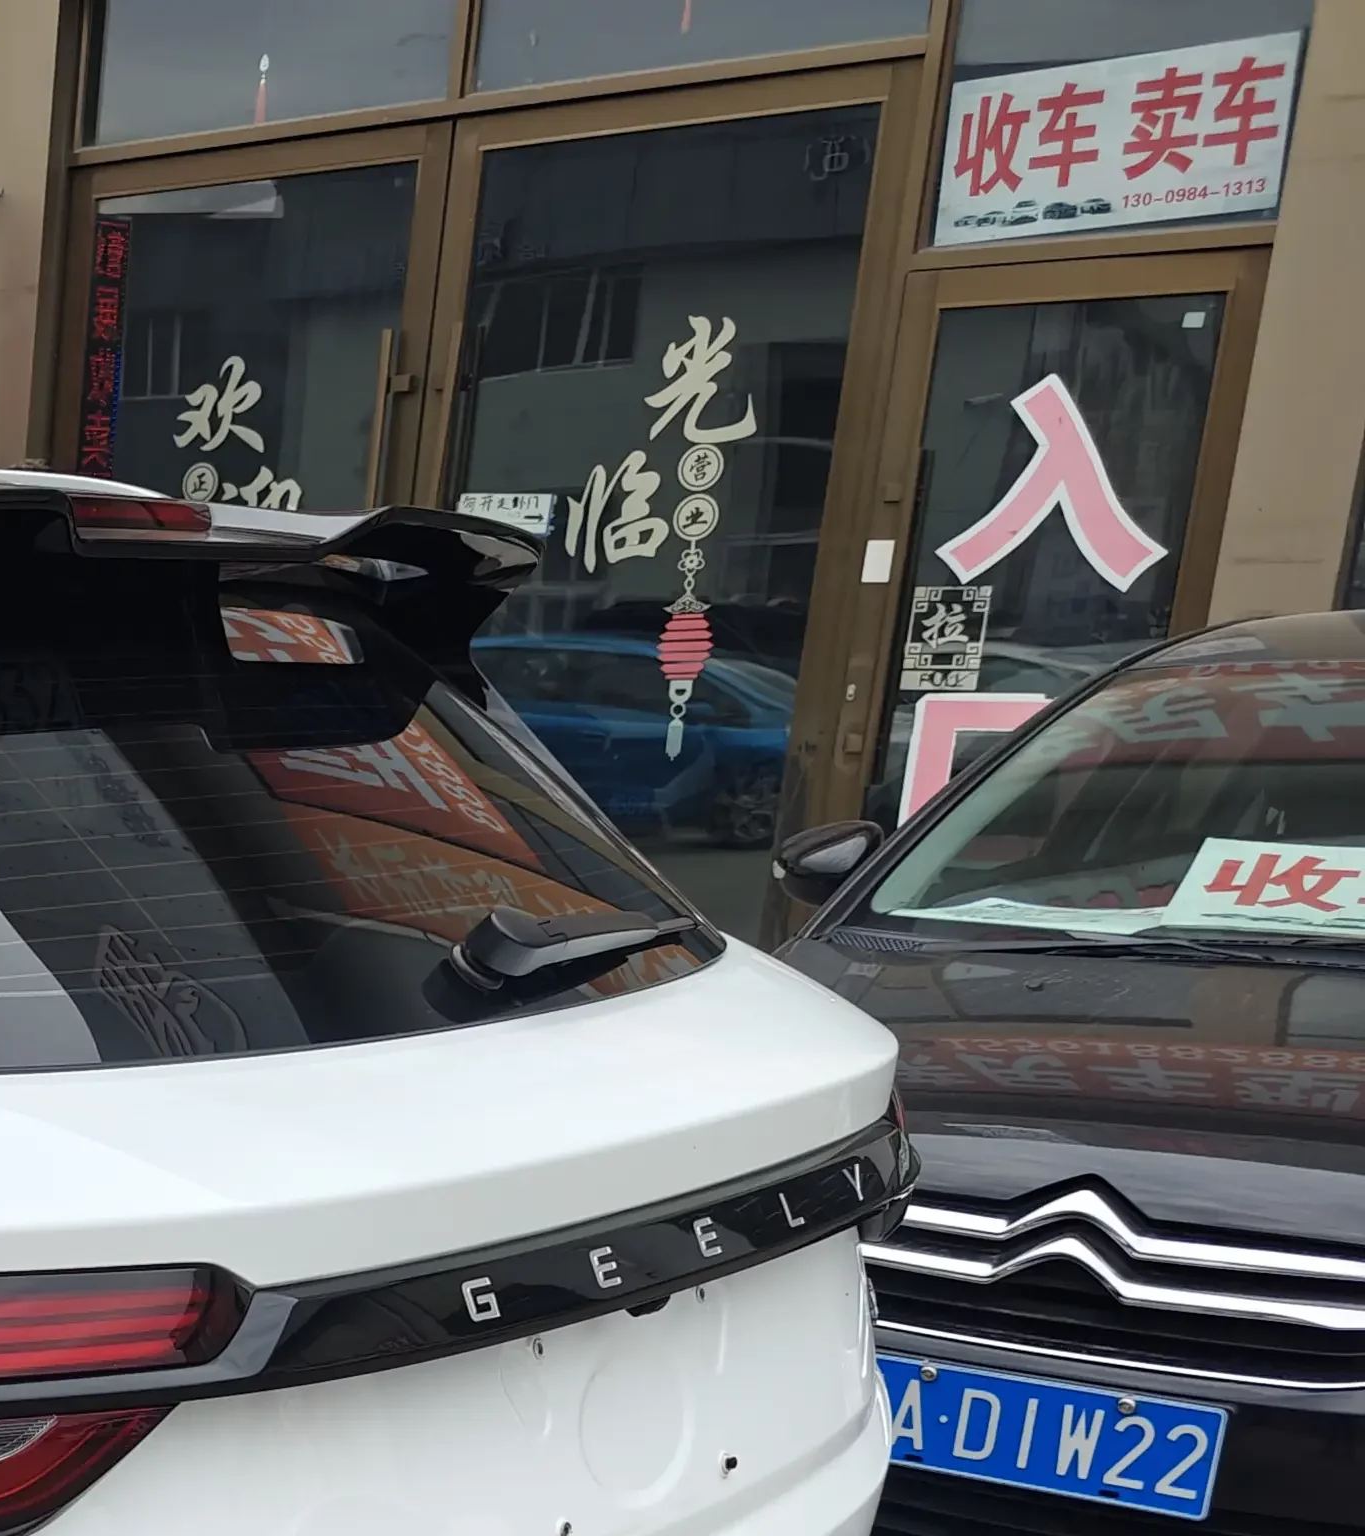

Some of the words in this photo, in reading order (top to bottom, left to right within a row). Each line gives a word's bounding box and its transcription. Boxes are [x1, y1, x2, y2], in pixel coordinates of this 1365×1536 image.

[954, 82, 1105, 197] 收车
[1122, 56, 1288, 181] 卖车
[1122, 178, 1267, 209] 130-0984-1313
[921, 602, 970, 649] 拉
[463, 1162, 866, 1323] GEELY
